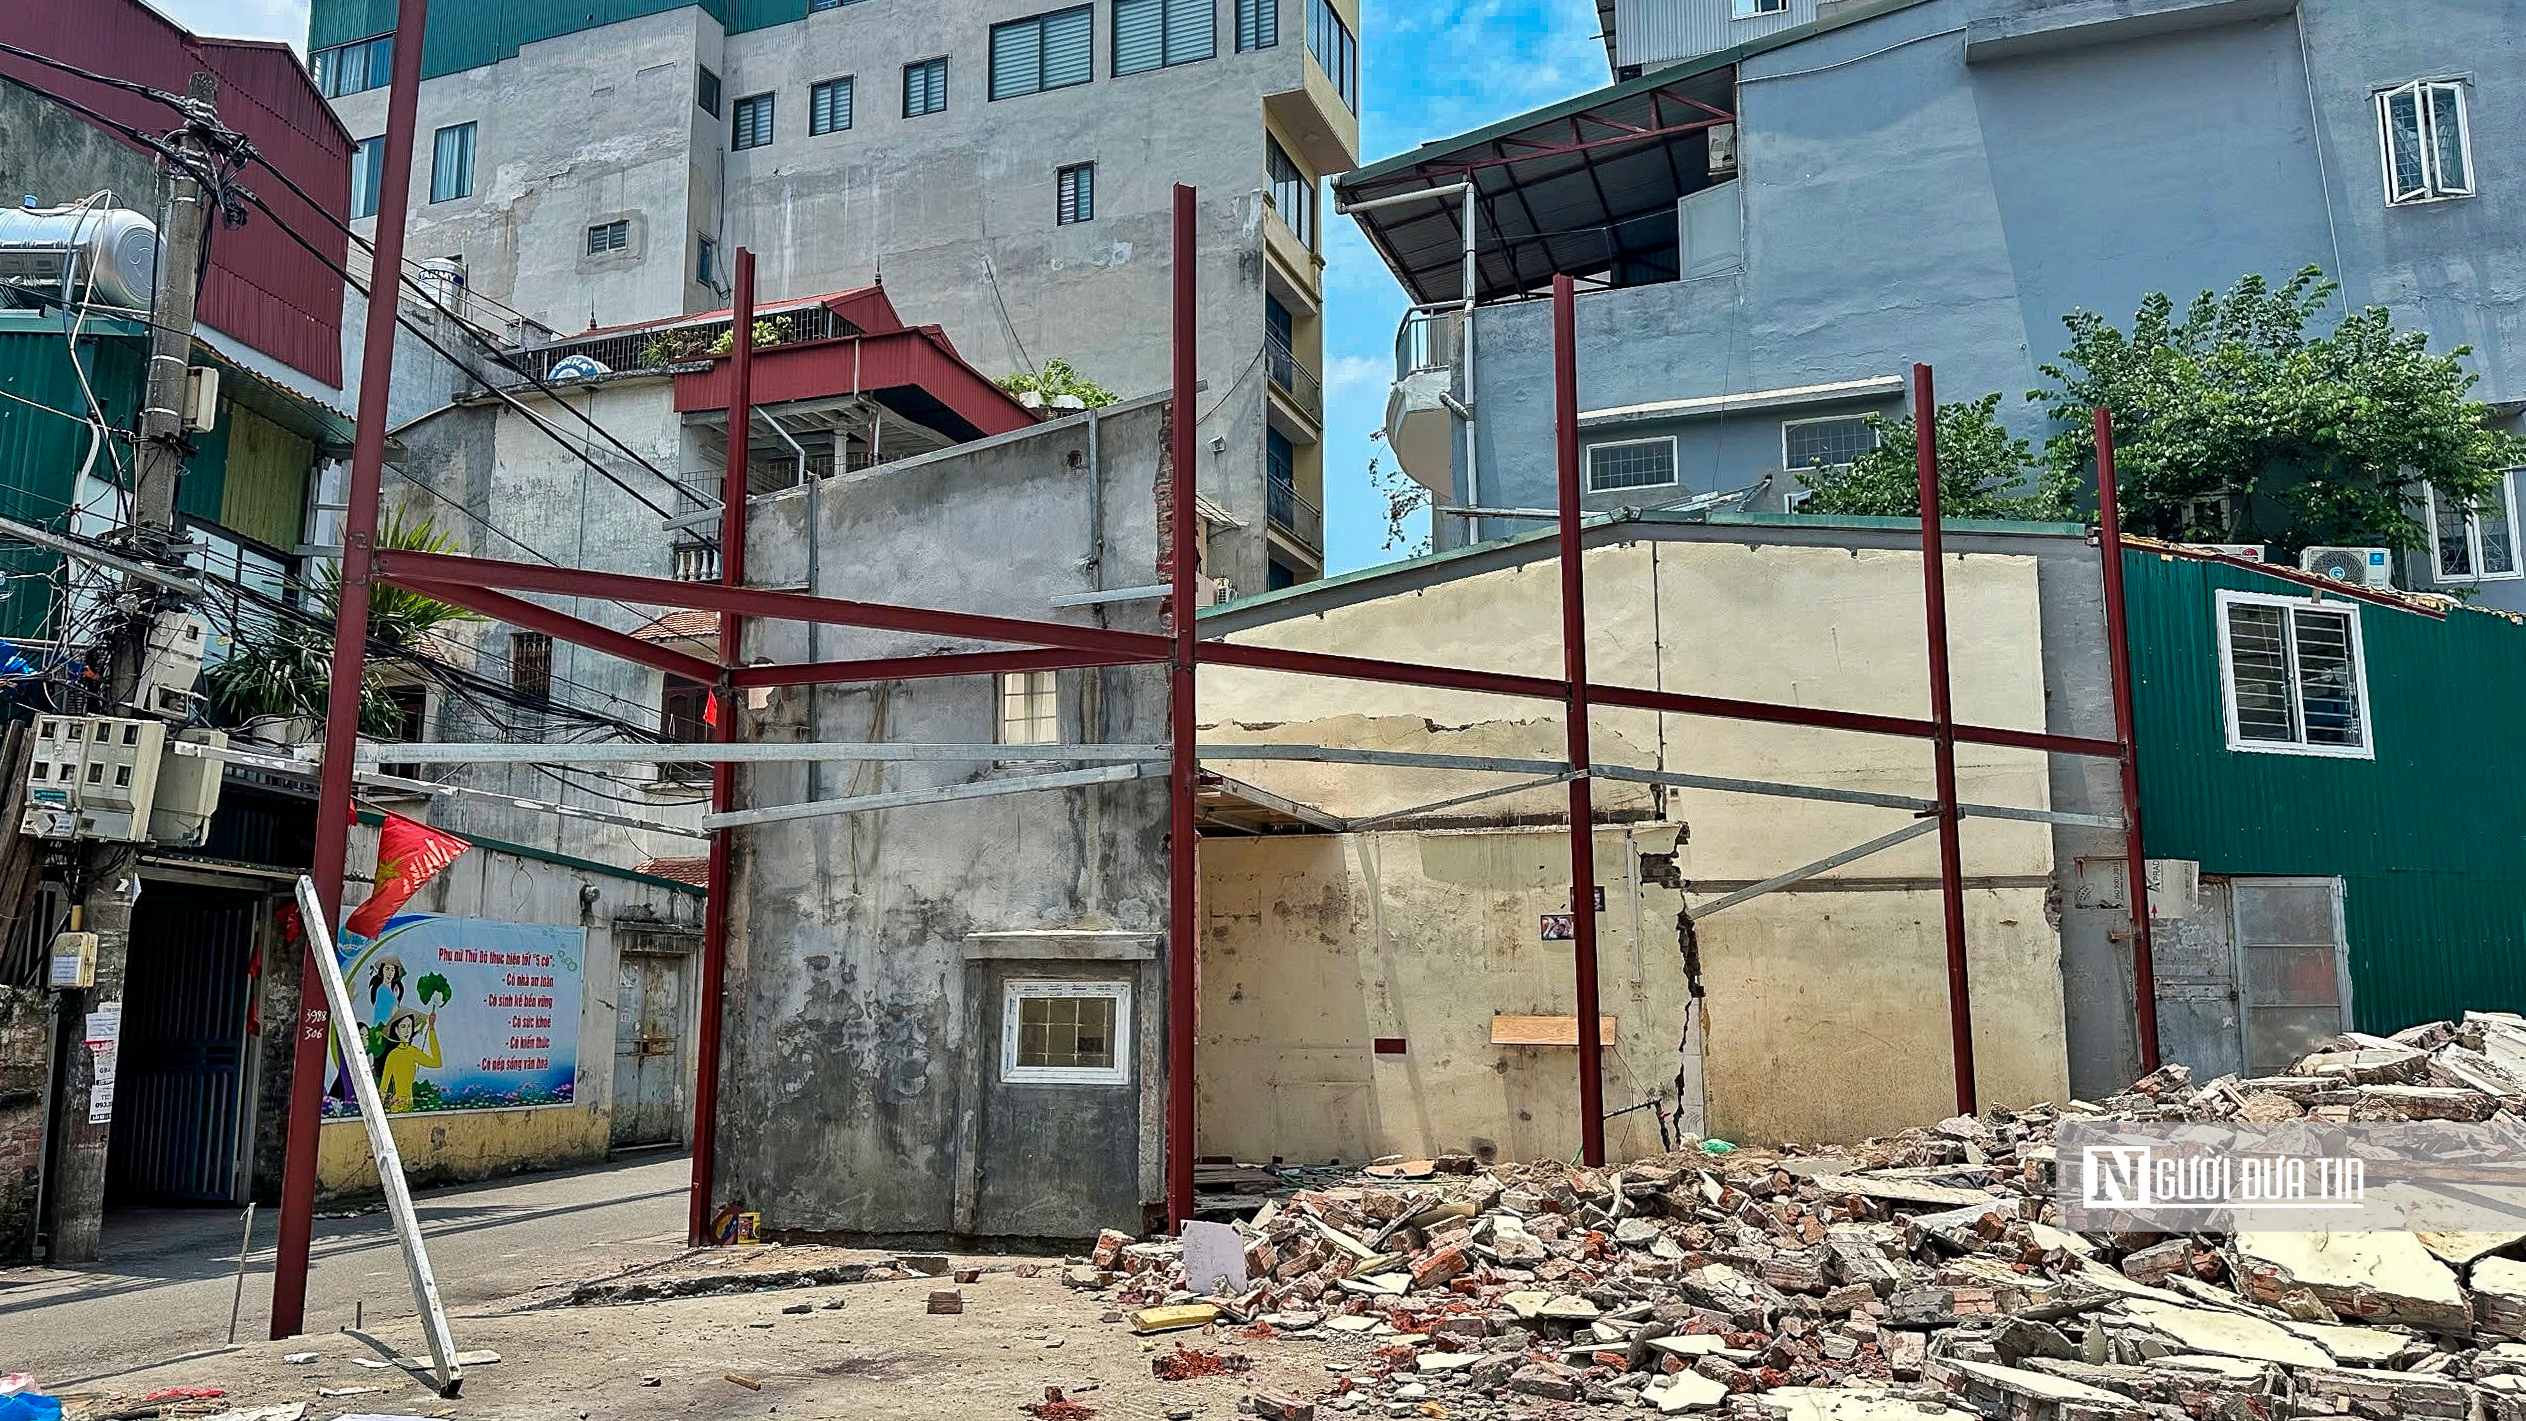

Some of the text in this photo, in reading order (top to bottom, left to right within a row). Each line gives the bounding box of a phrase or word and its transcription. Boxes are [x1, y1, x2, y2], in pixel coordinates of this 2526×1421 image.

[439, 948, 452, 964] Phụ
[465, 949, 477, 962] Thủ
[507, 973, 515, 986] Có
[489, 994, 497, 1007] Có
[499, 994, 513, 1007] sinh
[515, 993, 523, 1007] kế
[513, 1015, 521, 1028] Có
[523, 1015, 534, 1028] sức
[304, 1026, 323, 1040] 306
[510, 1036, 519, 1049] Có
[521, 1034, 534, 1049] kiến
[482, 1058, 491, 1071] Có
[492, 1055, 504, 1071] nếp
[506, 1055, 522, 1071] sống
